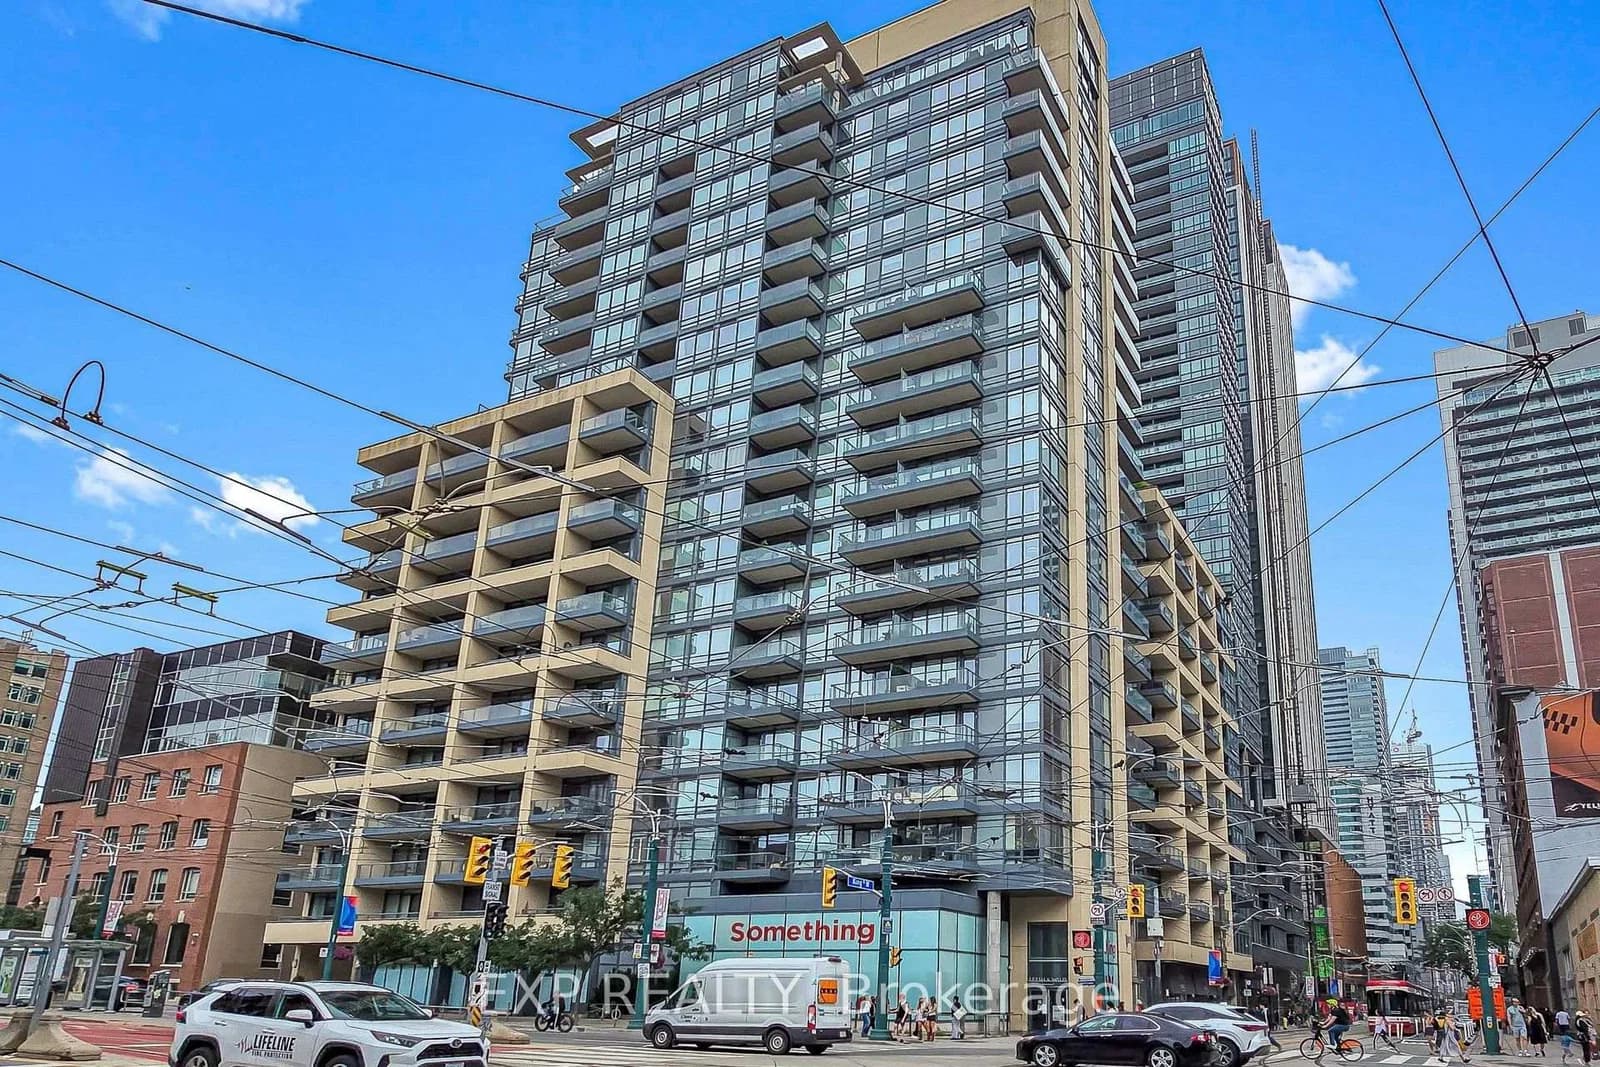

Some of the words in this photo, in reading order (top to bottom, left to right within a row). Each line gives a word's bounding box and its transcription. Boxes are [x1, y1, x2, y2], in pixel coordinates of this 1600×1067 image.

[1366, 796, 1376, 834] HYATT
[731, 920, 875, 944] Something
[253, 1034, 296, 1051] LIFELINE
